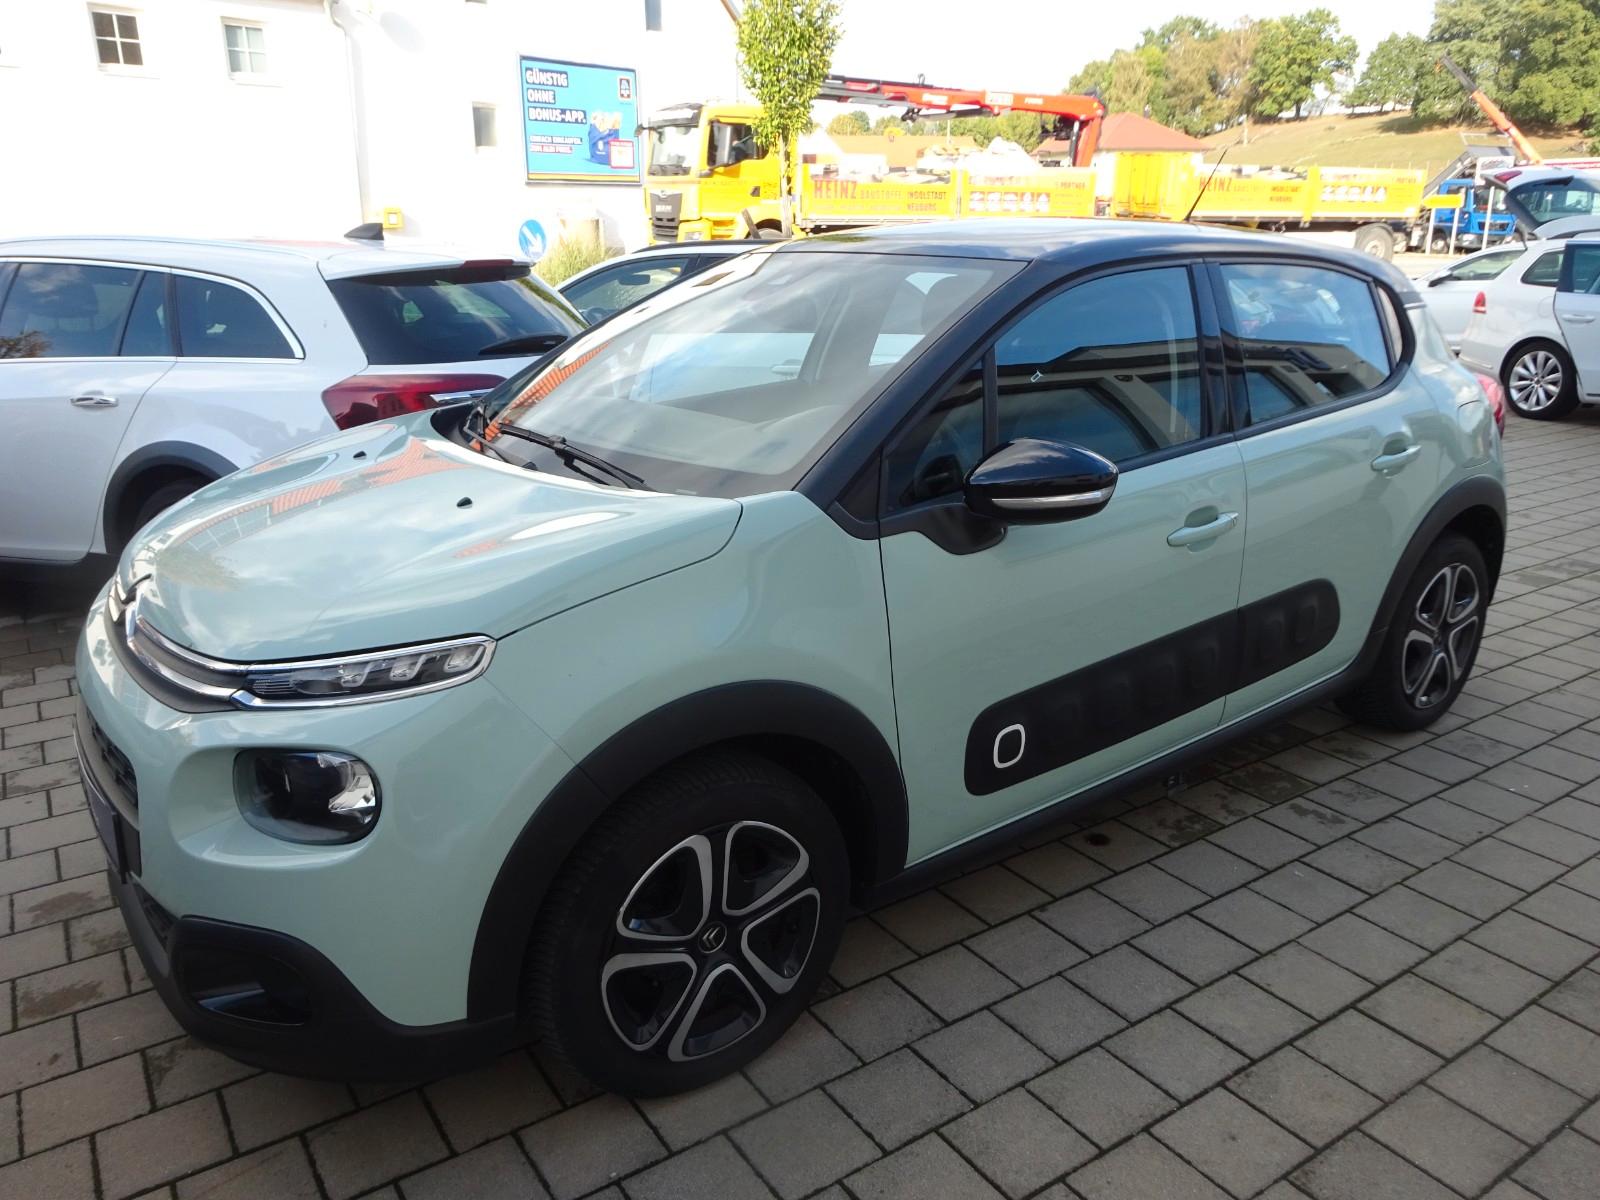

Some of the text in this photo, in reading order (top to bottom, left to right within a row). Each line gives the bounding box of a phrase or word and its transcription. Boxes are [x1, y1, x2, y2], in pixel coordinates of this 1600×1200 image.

[525, 67, 568, 86] GÜNSTIG
[527, 89, 555, 103] OHNE
[528, 107, 586, 123] BONUS-APP.
[814, 179, 857, 199] HEINZ
[907, 190, 947, 200] INGOLSTADT
[1198, 176, 1232, 192] HEINZ
